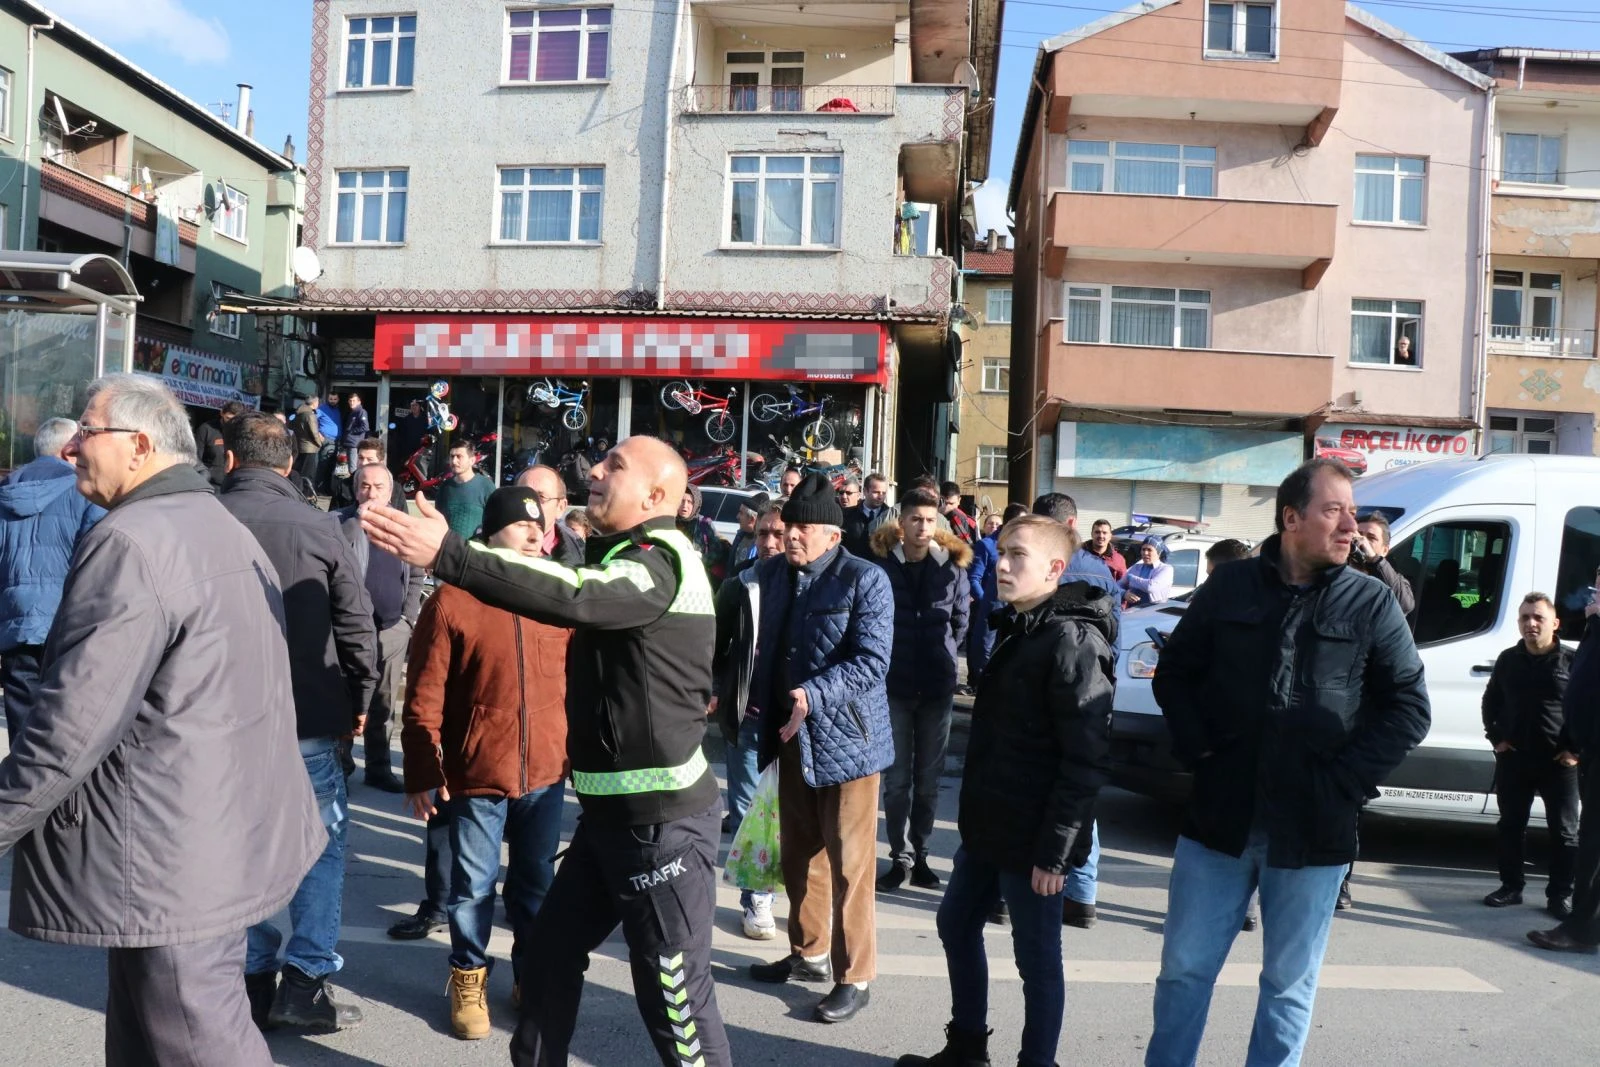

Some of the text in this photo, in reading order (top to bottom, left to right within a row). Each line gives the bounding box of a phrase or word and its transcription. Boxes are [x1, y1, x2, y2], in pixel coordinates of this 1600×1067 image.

[172, 358, 237, 386] ebrar manav
[1340, 428, 1469, 455] ERÇELİK OTO
[1433, 792, 1474, 802] MAHSUSTUR
[464, 974, 477, 984] CAT
